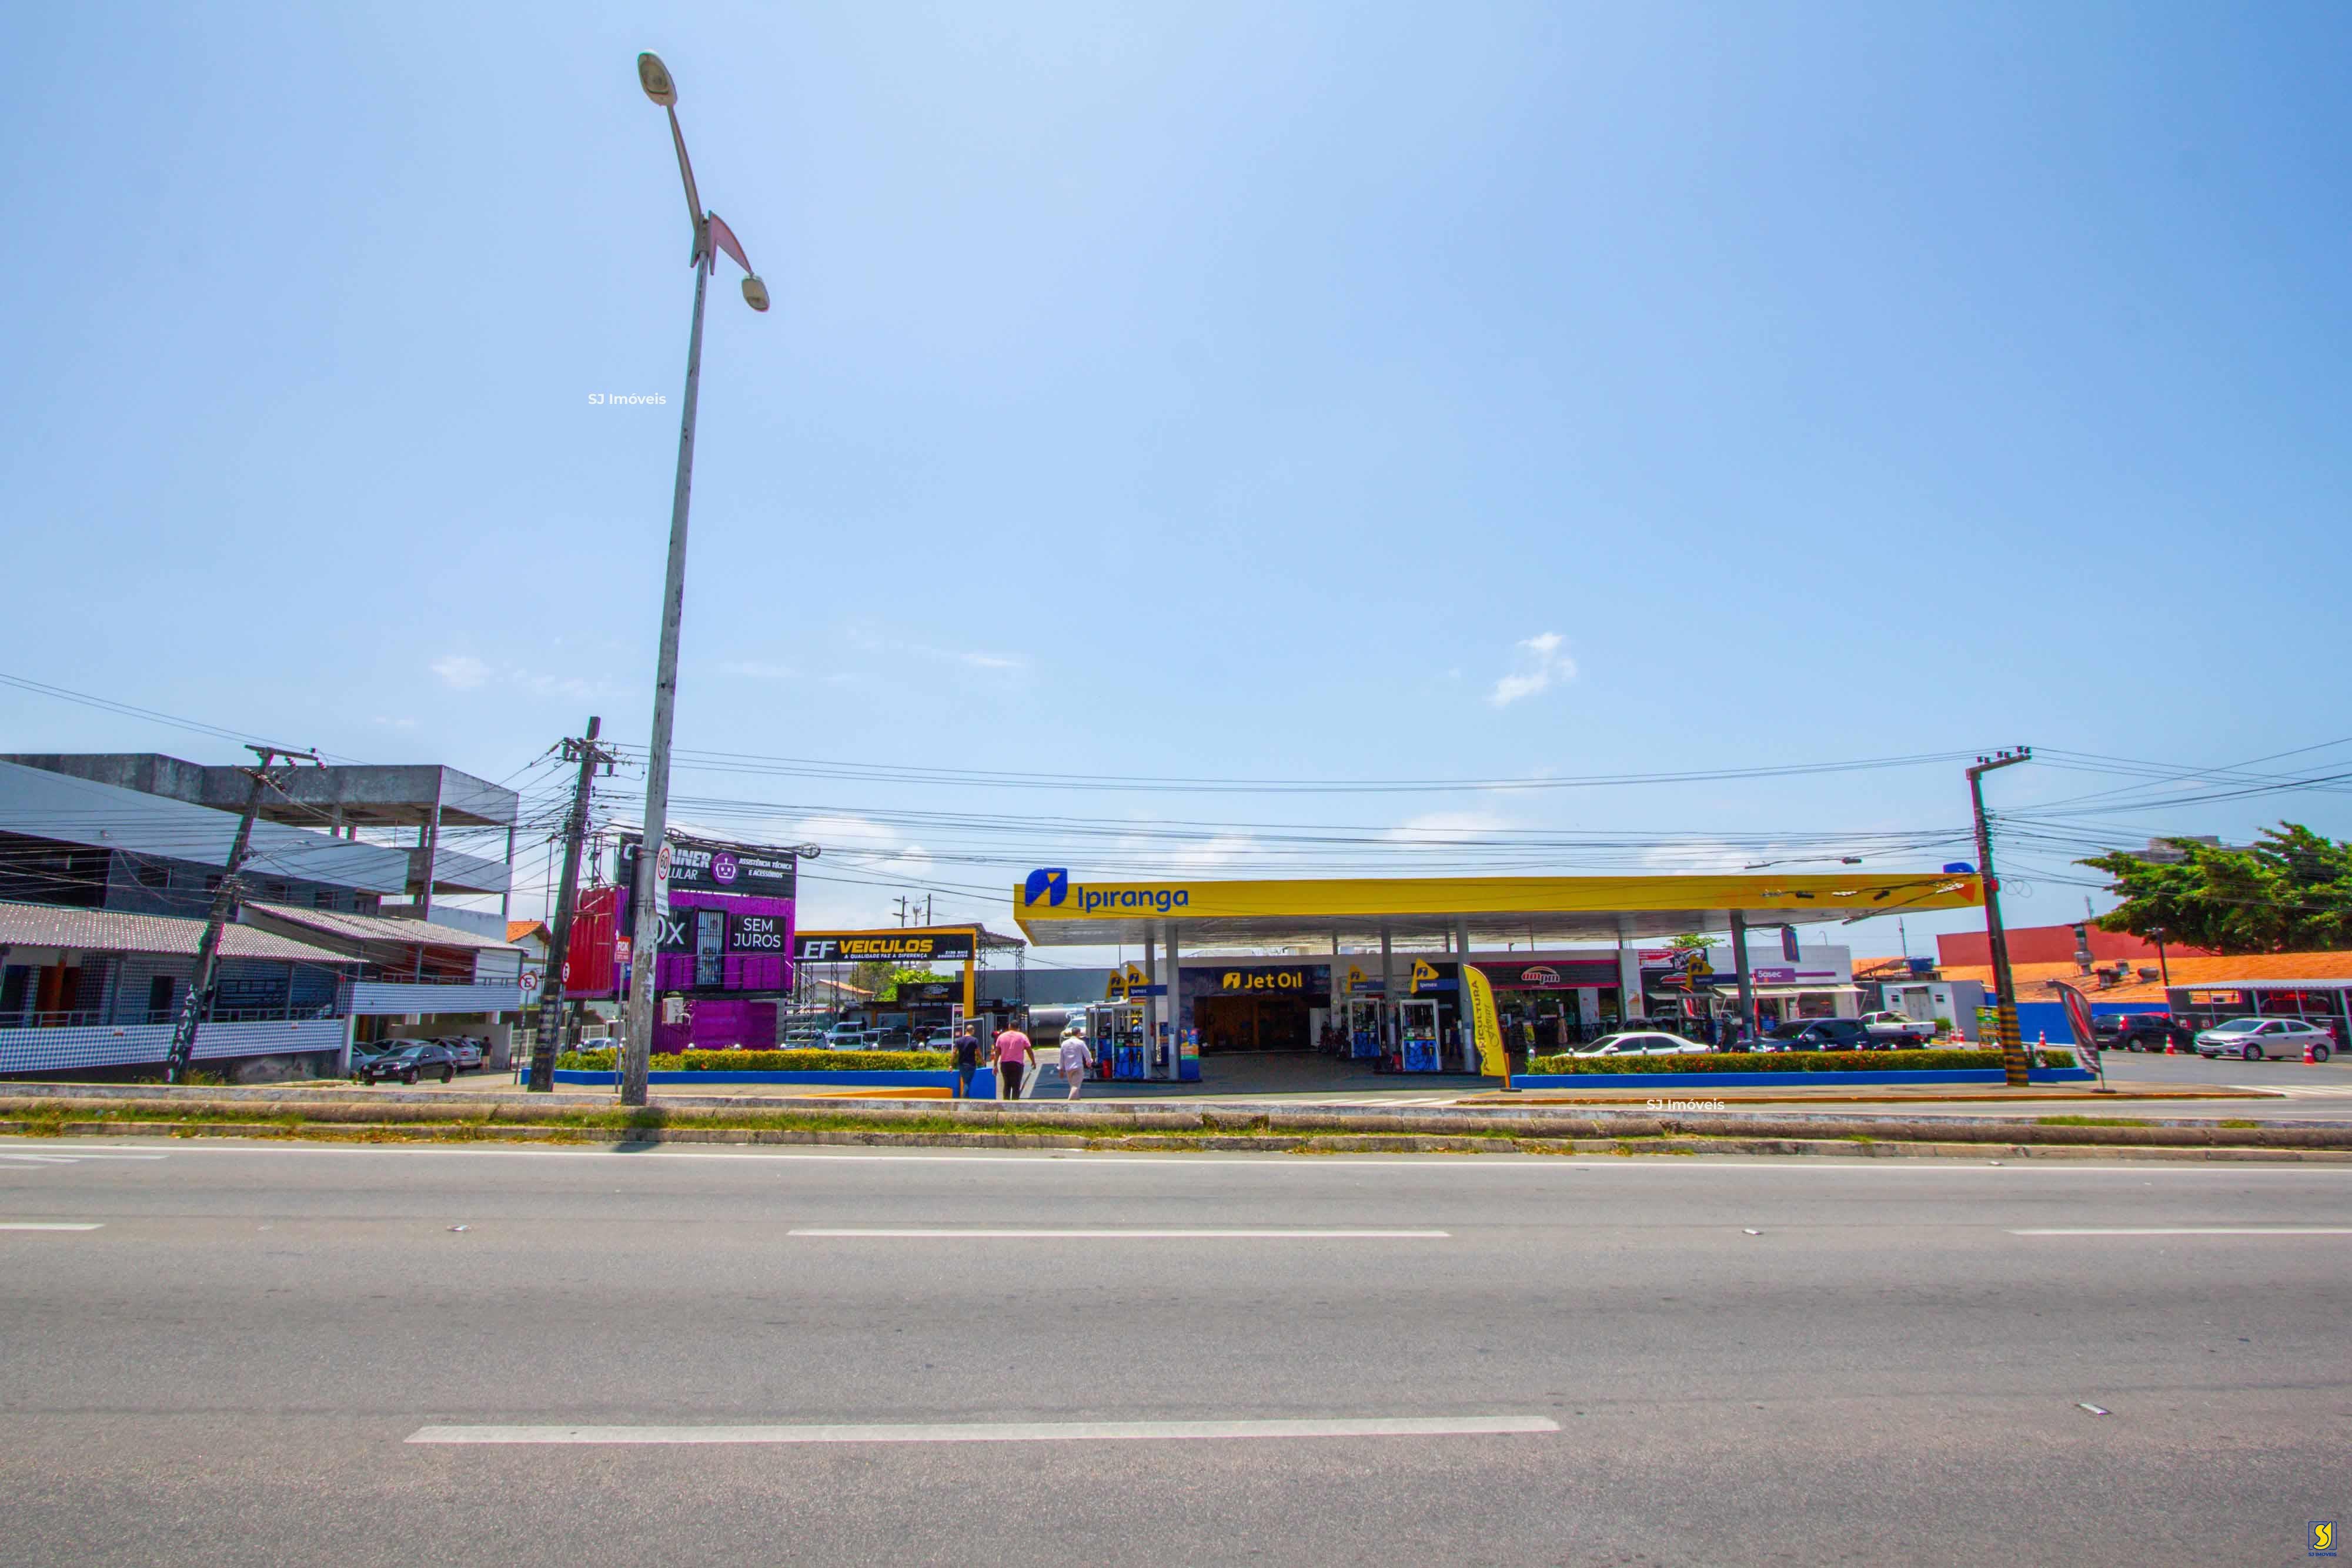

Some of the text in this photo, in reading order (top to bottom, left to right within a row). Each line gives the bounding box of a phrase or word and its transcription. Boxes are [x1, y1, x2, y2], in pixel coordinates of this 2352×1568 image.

[772, 860, 792, 870] TÉCNICA
[1078, 886, 1188, 913] Ipiranga
[743, 918, 773, 932] SEM
[733, 933, 781, 948] JUROS
[803, 940, 934, 959] EF VEICULOS
[1244, 971, 1303, 988] Jet Oil
